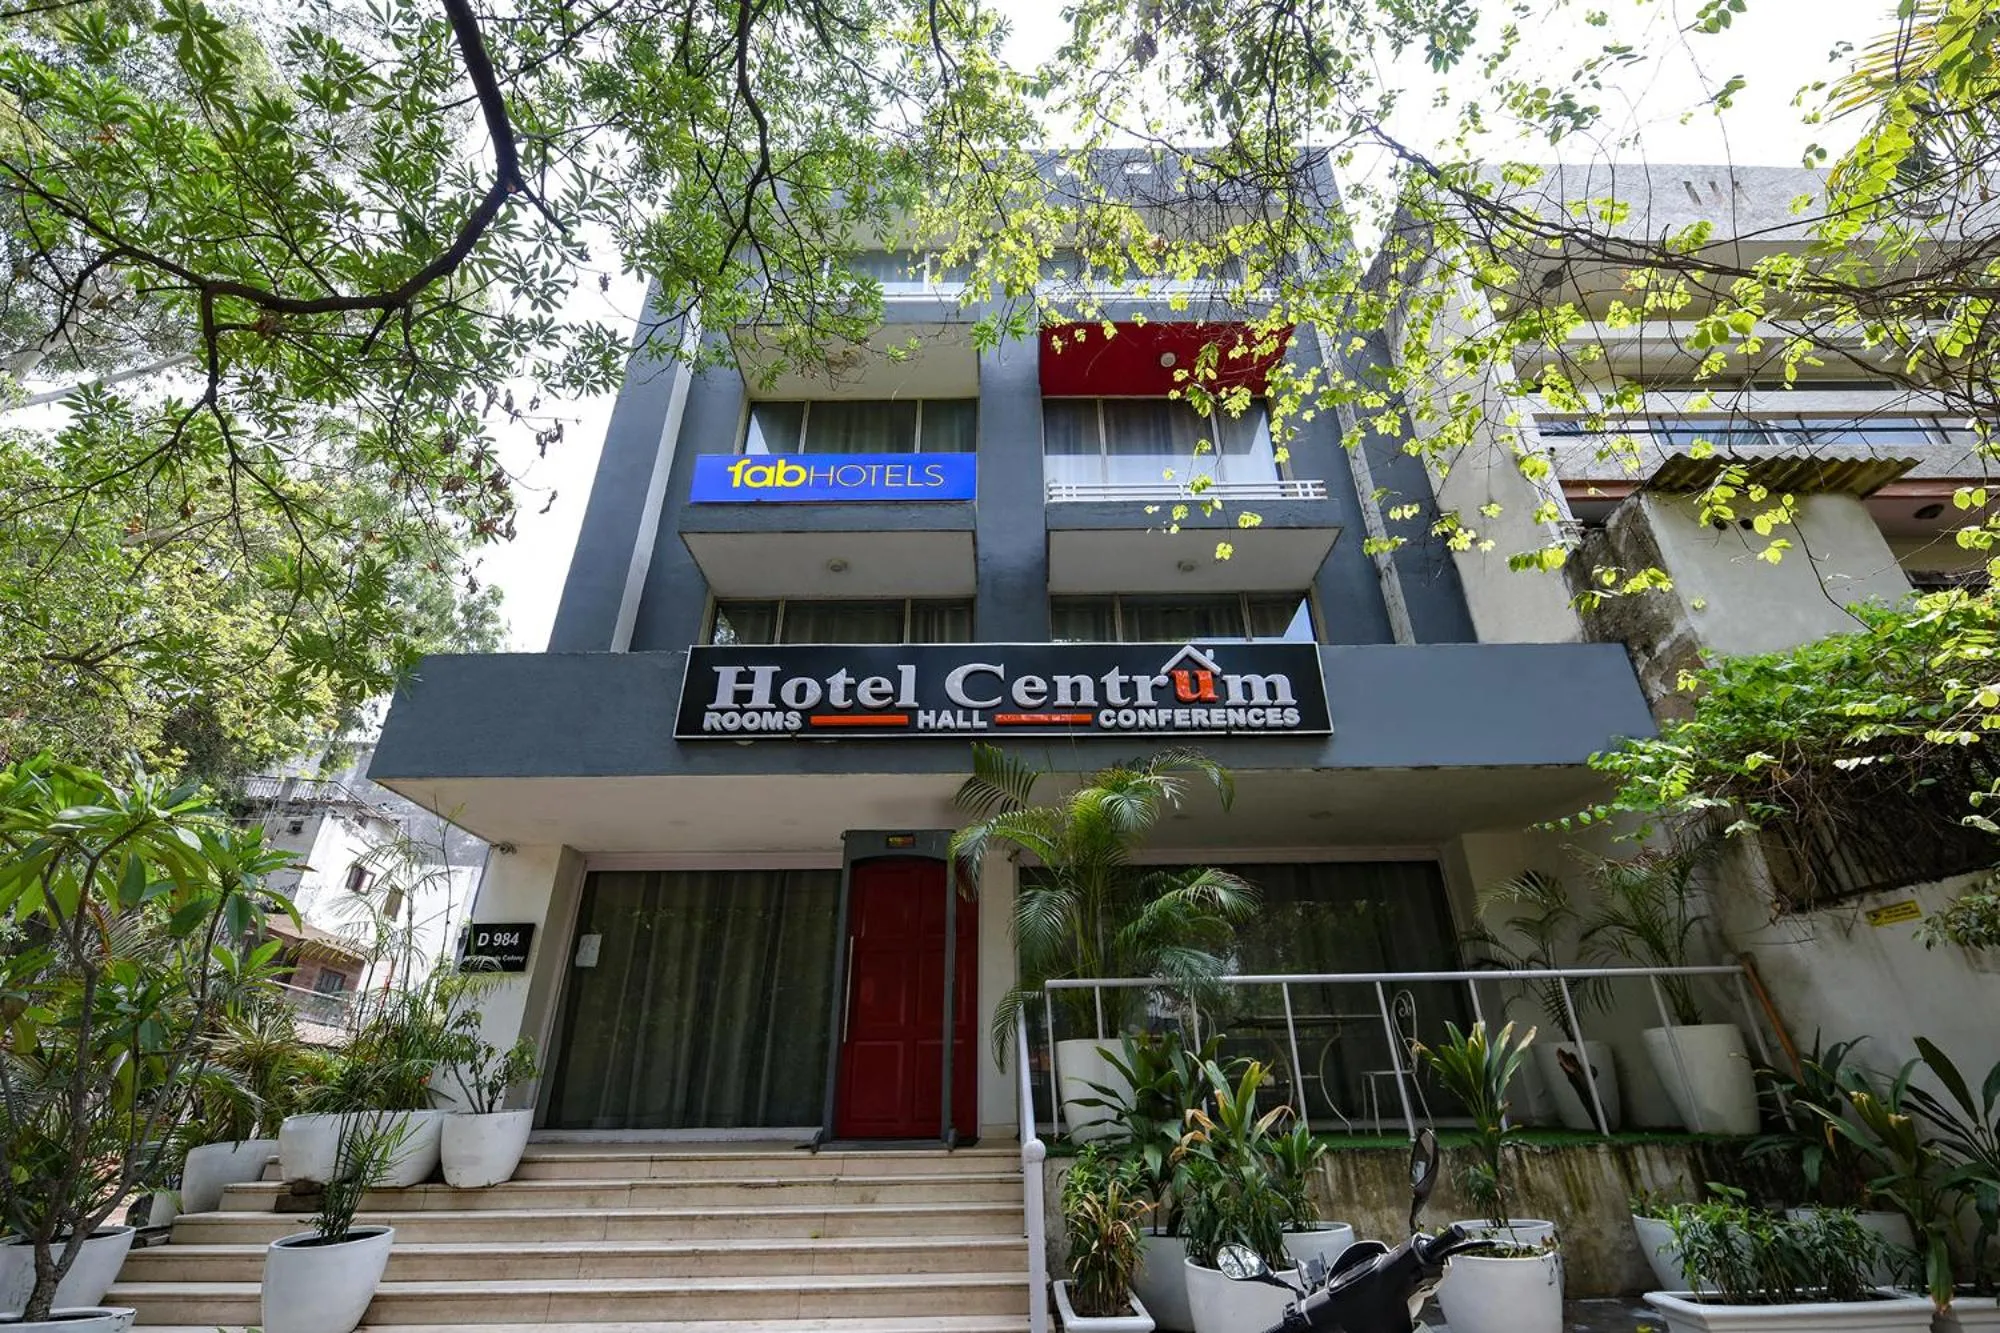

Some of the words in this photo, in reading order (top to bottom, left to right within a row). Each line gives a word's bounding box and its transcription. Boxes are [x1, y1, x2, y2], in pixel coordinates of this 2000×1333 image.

[706, 663, 919, 710] Hotel
[944, 662, 1298, 709] Centrum
[702, 710, 803, 732] ROOMS
[916, 710, 989, 730] HALL
[1098, 707, 1301, 729] CONFERENCES
[477, 932, 490, 947] D
[492, 932, 520, 947] 984
